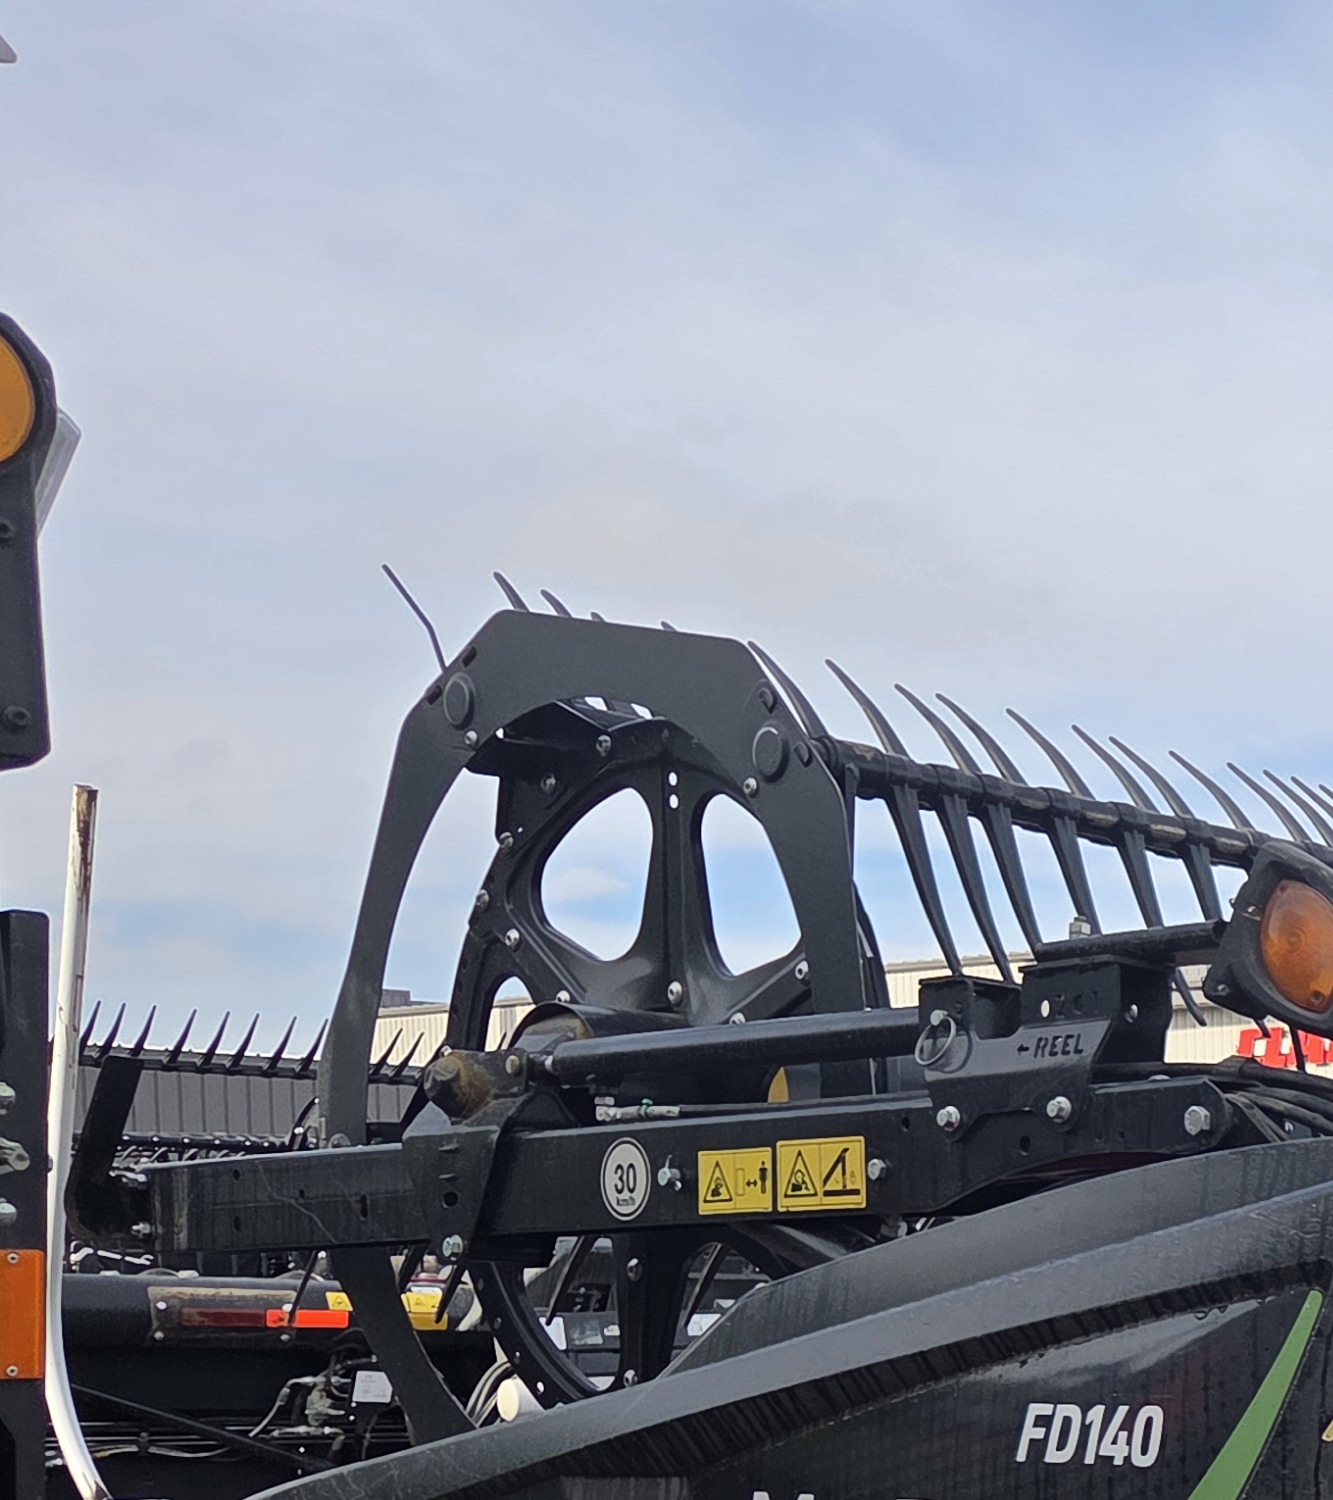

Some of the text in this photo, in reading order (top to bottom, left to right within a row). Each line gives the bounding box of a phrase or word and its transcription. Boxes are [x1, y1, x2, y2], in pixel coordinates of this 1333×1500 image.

[1033, 1033, 1084, 1058] REEL
[614, 1162, 637, 1194] 30
[1015, 1402, 1164, 1468] FD140
